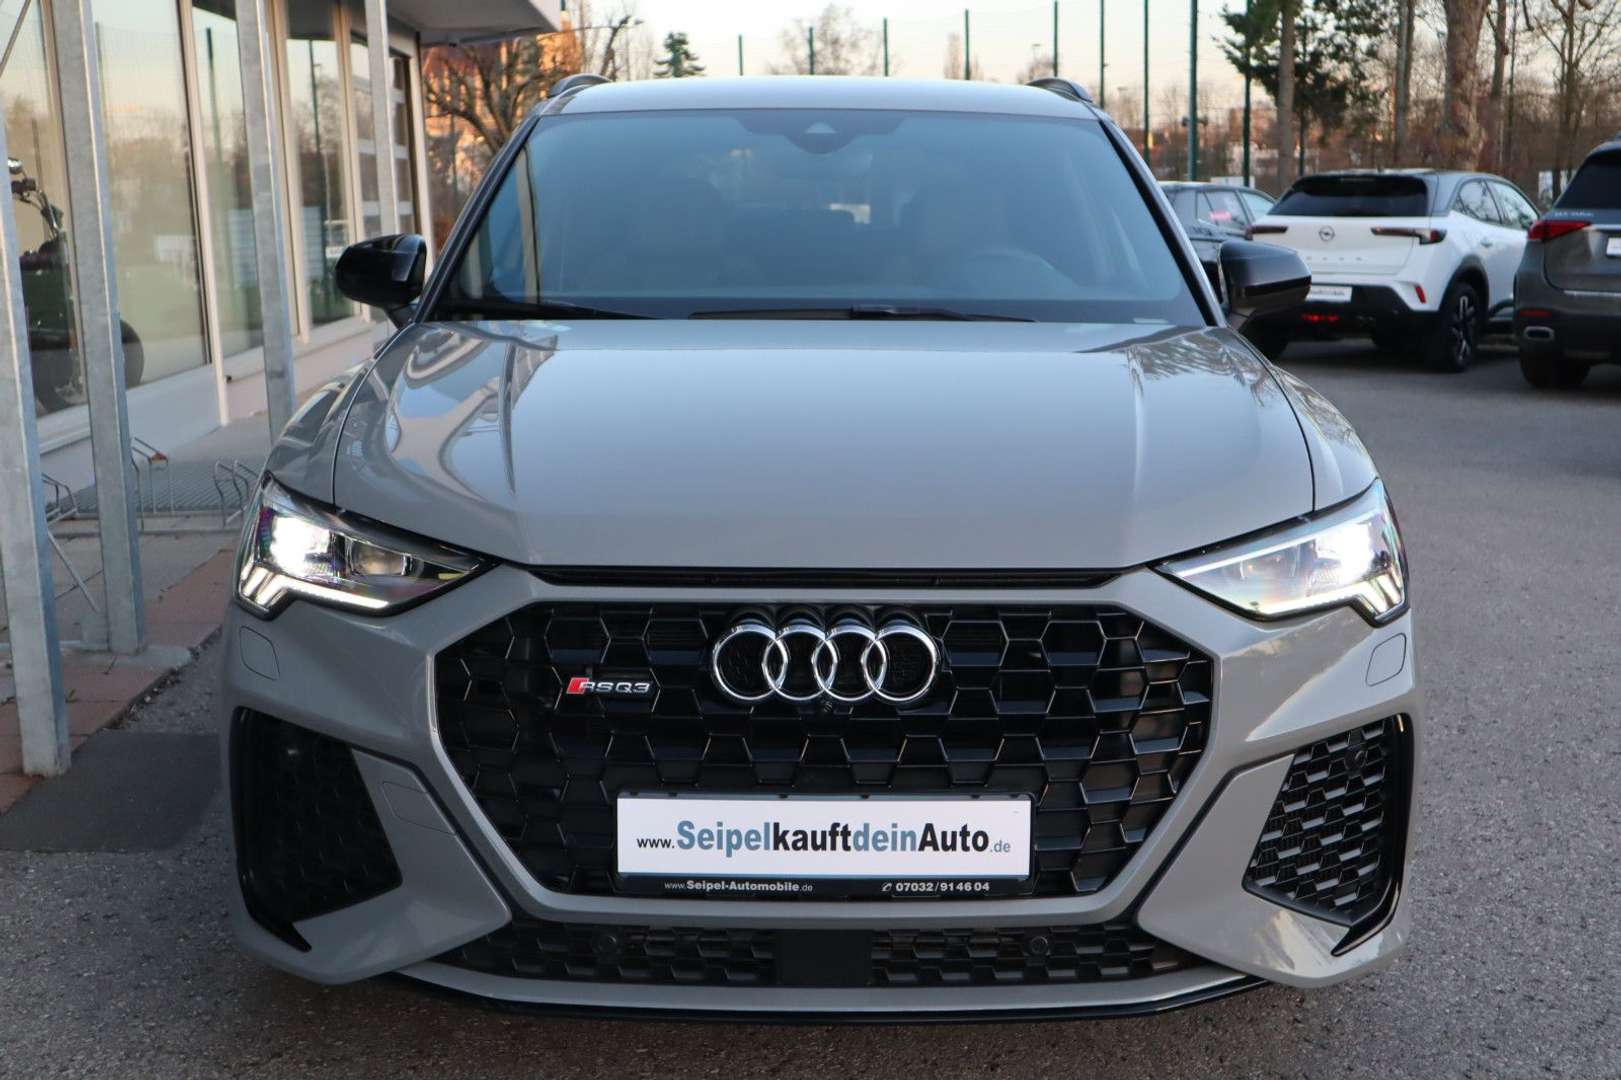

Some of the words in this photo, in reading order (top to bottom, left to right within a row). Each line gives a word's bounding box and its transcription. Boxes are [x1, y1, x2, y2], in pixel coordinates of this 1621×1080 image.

[579, 681, 651, 694] RSQ3
[636, 820, 1011, 857] www.SeipelkauftdeinAuto.de
[664, 880, 813, 892] www.Seipel-Automobile.de
